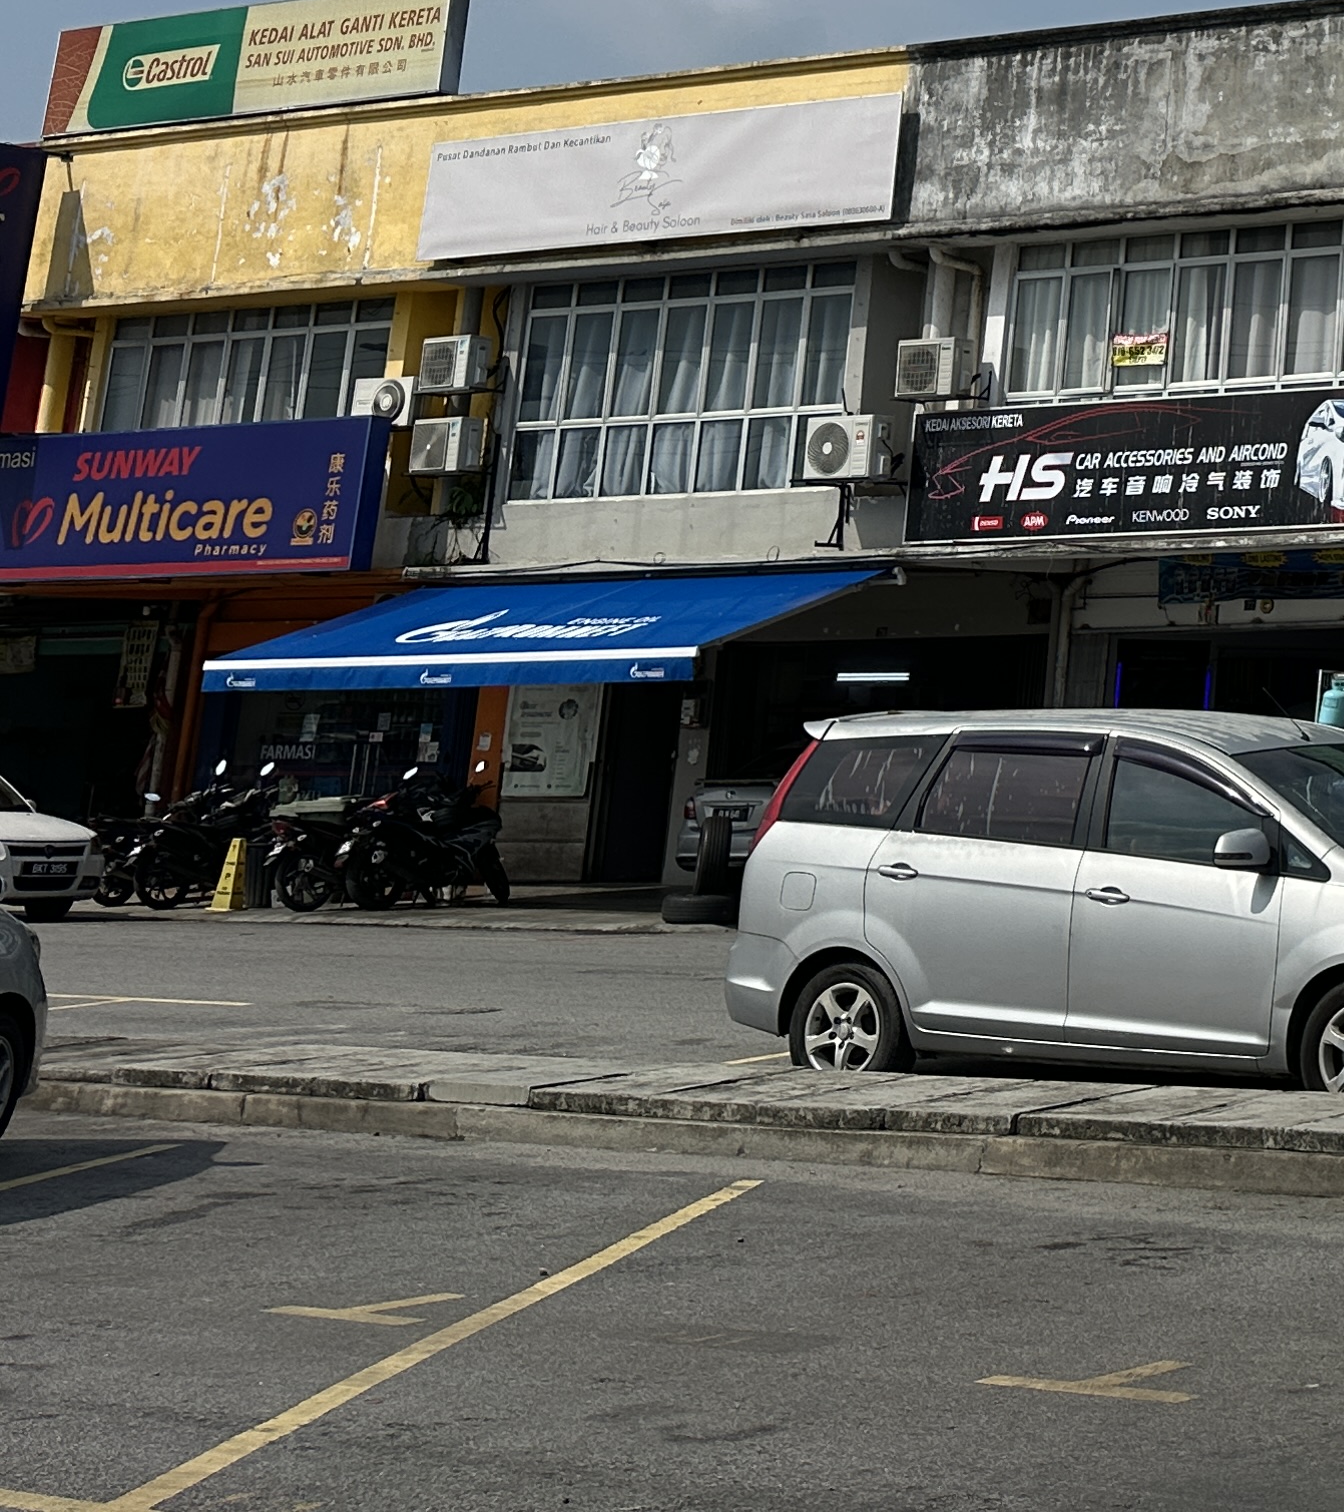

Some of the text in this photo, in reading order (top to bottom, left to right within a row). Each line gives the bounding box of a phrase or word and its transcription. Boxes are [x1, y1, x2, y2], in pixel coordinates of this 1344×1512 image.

[248, 6, 441, 47] KEDAI ALAT GANTI KERETA
[245, 31, 436, 69] SAN SUI AUTOMOTIVE SDN. BHD.
[145, 50, 210, 85] Castrol
[437, 134, 611, 162] Pusat Dandanan Rambut Dan Kecantikan
[586, 214, 701, 236] Hair & Beauty Saloon
[925, 413, 1023, 433] KEDAI AKSESORI KERETA
[72, 446, 203, 482] SUNWAY
[1075, 442, 1289, 471] CAR ACCESSORIES AND AIRCOND
[978, 451, 1075, 503] HS
[1072, 469, 1282, 499] 汽车音响冷气装饰
[317, 452, 346, 544] 康乐药剂
[57, 489, 273, 546] Multicare
[1023, 515, 1046, 528] APM
[1065, 513, 1115, 526] Pioneer
[1131, 508, 1190, 524] KENWOOD
[1206, 504, 1261, 521] SONY
[194, 542, 268, 557] Pharmacy
[260, 744, 316, 761] FARMASI
